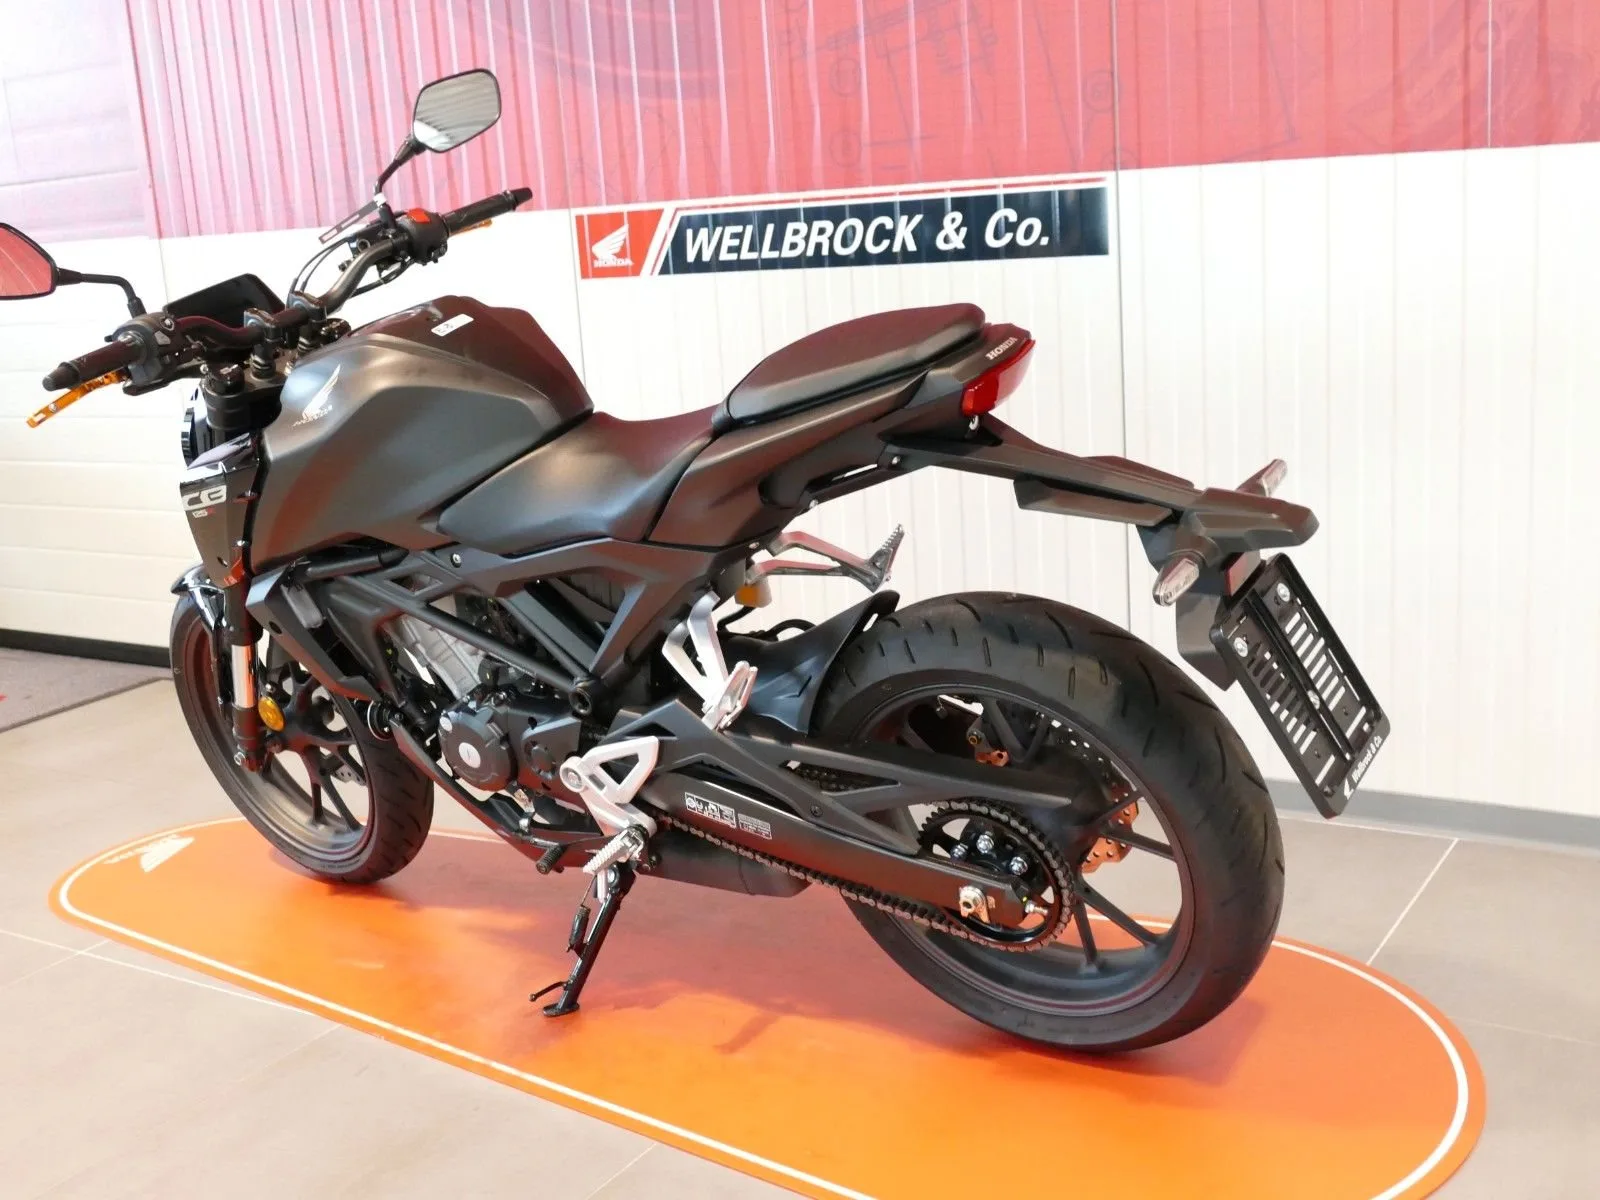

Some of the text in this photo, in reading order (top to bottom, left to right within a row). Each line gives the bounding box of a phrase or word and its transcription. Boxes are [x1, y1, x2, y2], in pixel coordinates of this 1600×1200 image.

[686, 208, 1049, 262] WELLBROCK & Co.
[593, 257, 634, 268] HONDA
[985, 336, 1018, 360] HONDA
[181, 485, 227, 511] CB
